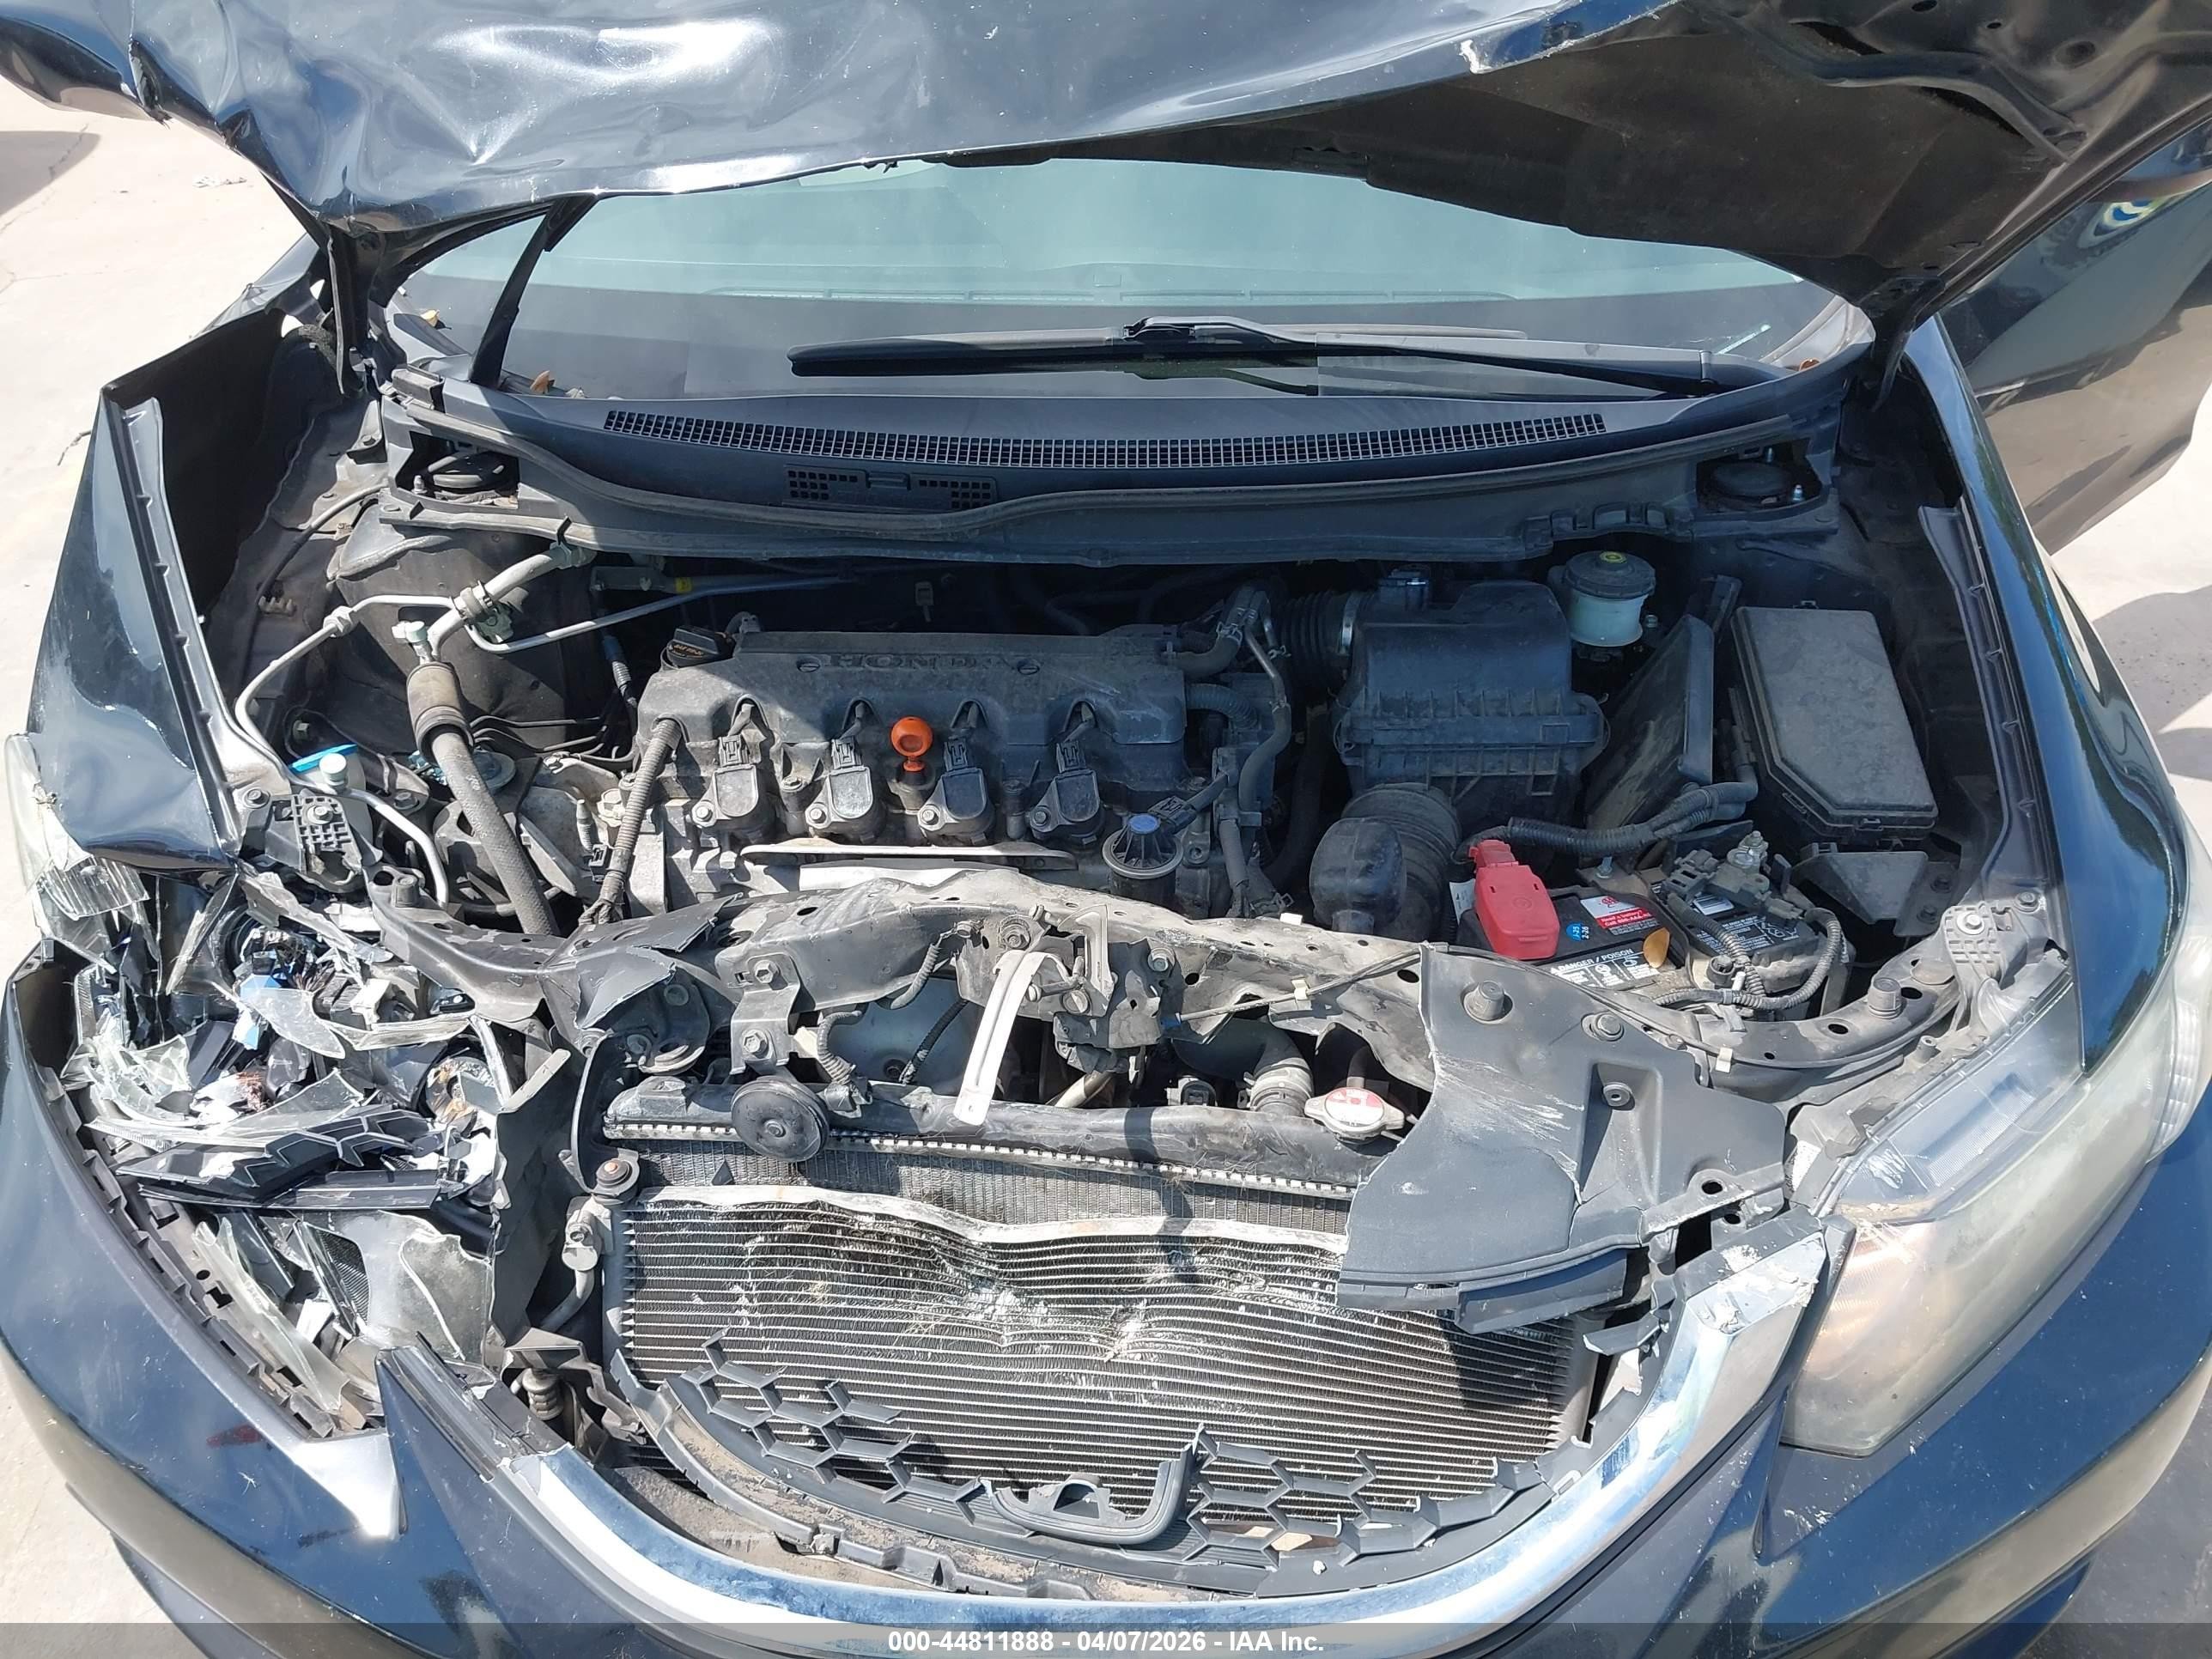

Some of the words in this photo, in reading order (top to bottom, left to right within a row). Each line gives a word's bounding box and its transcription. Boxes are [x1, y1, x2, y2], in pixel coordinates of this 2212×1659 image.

[830, 653, 1016, 670] HONDA
[1558, 958, 1595, 970] DANGER
[1601, 949, 1635, 961] POISON
